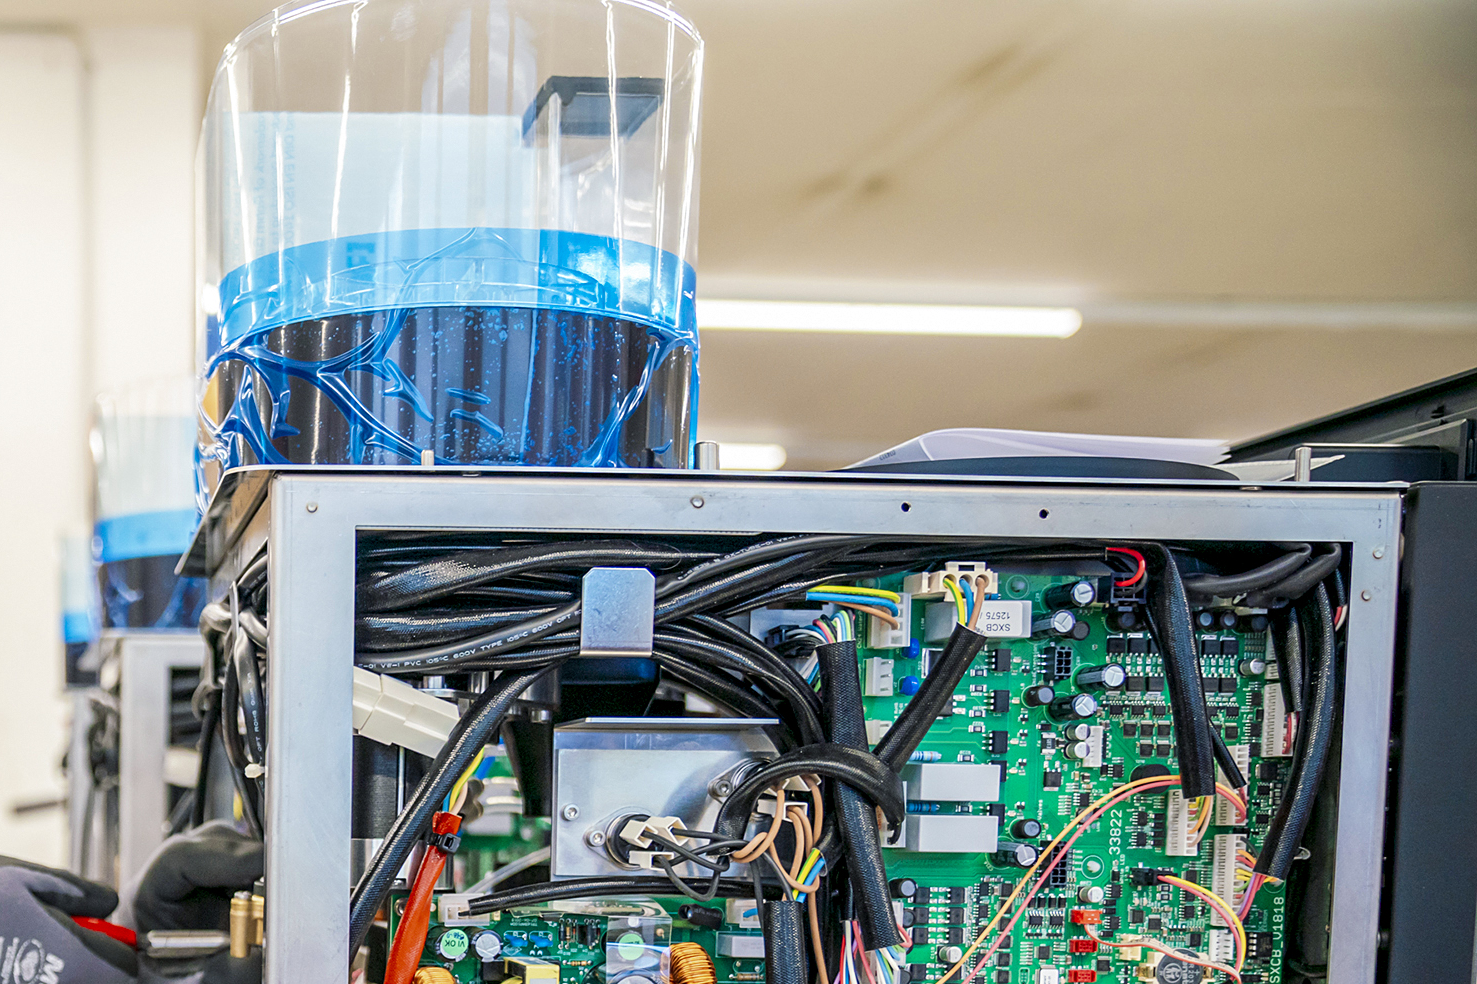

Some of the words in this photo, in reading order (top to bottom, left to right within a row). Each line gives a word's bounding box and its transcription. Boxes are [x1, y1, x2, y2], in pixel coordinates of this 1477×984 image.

[986, 611, 1011, 620] 12575
[986, 623, 1011, 632] SXCB
[452, 648, 477, 659] 600V
[480, 640, 503, 651] TYPE
[531, 621, 553, 633] 600V
[556, 613, 572, 624] OPT
[1108, 809, 1123, 855] 33822
[444, 939, 457, 948] OK
[1269, 896, 1284, 984] SXCB_V1818
